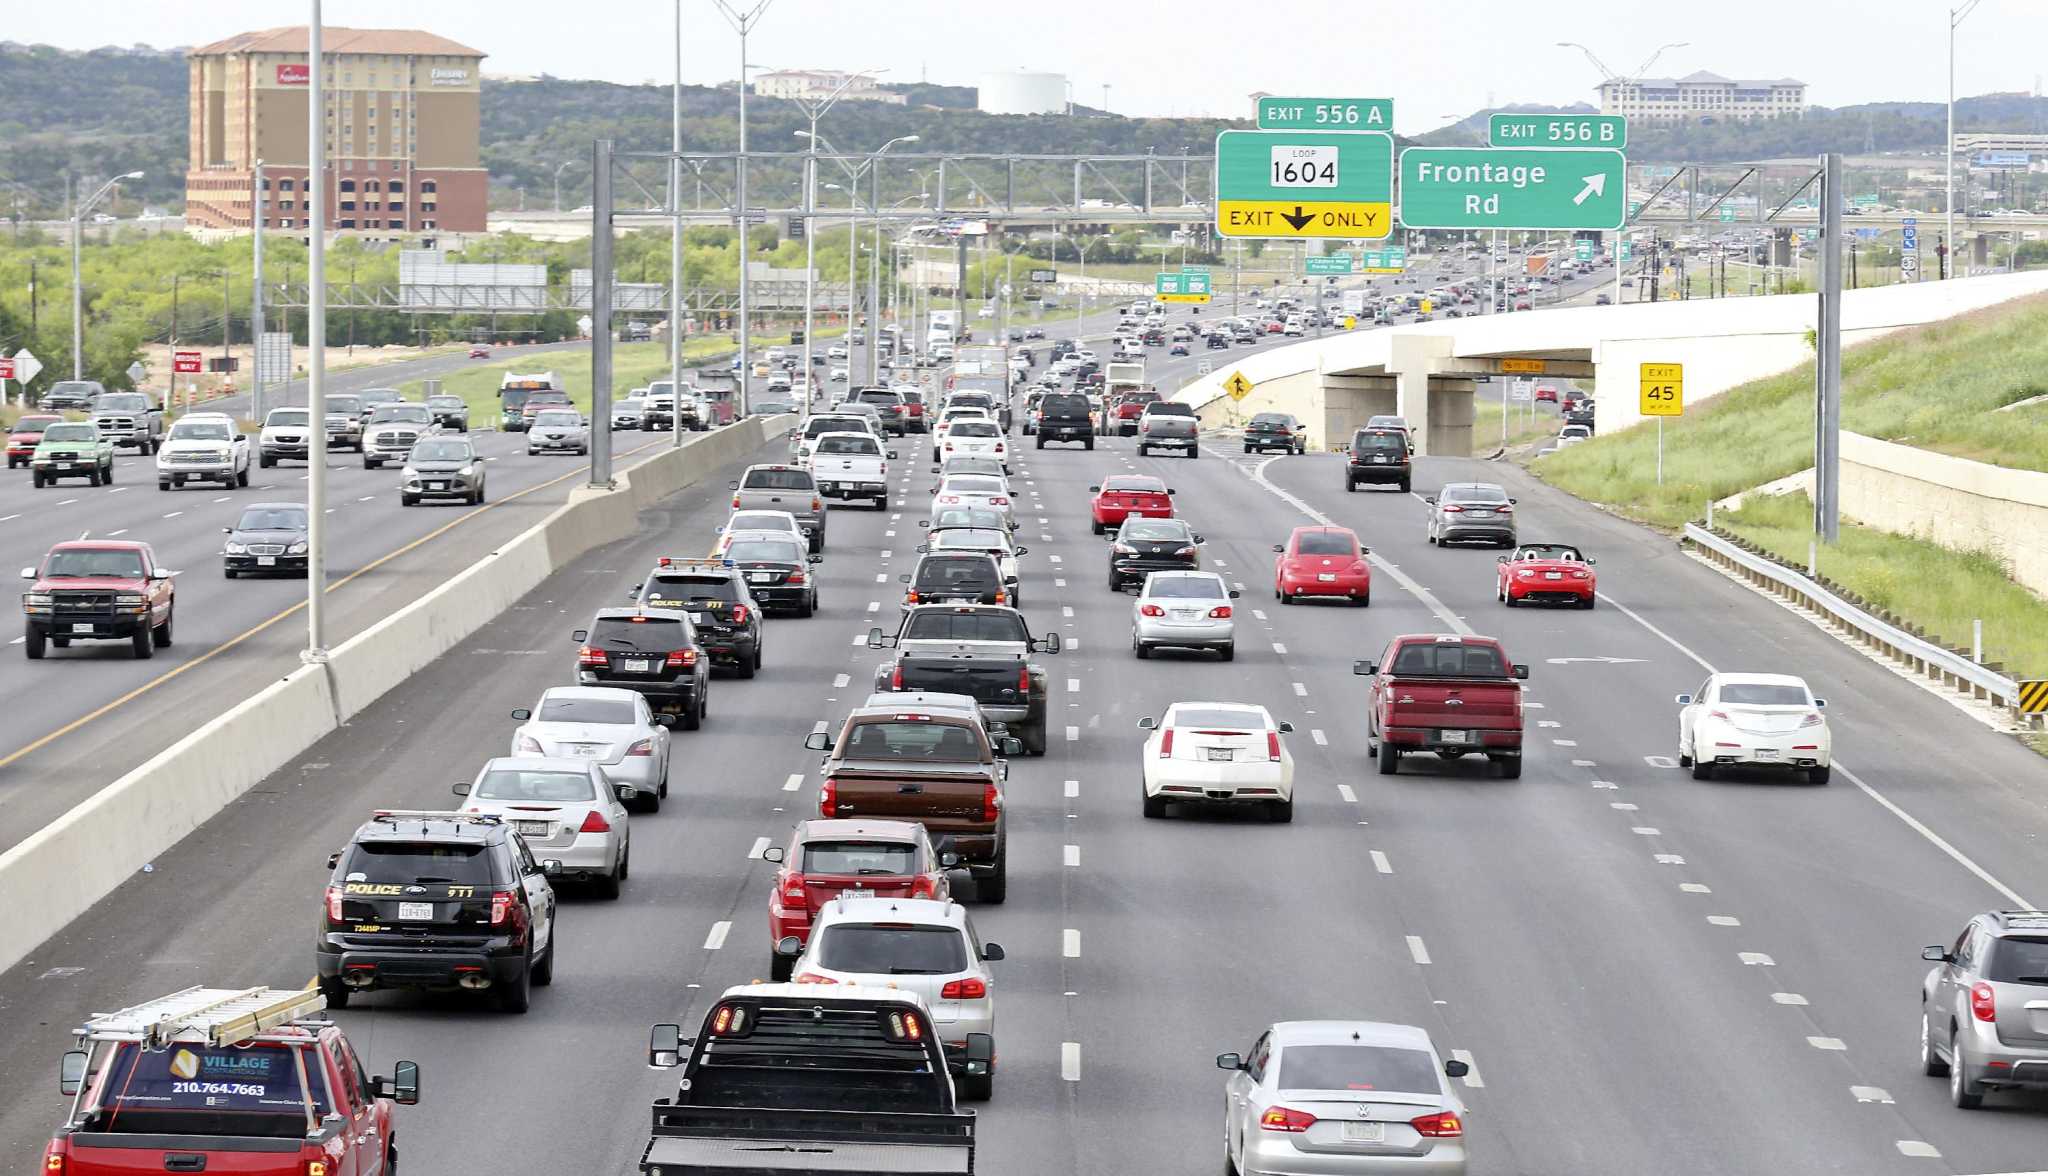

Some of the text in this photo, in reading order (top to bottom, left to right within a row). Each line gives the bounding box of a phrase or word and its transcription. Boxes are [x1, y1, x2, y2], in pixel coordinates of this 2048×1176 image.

[1268, 105, 1384, 125] EXIT 556 A
[1501, 121, 1615, 142] EXIT 556 B
[1292, 149, 1318, 158] LOOP
[1273, 160, 1336, 184] 1604
[1418, 162, 1547, 188] Frontage
[1465, 194, 1500, 215] Rd
[1230, 211, 1377, 227] EXIT ONLY
[1649, 368, 1674, 377] EXIT
[1647, 386, 1674, 401] 45
[345, 883, 402, 895] POLICE
[448, 889, 473, 898] 911
[204, 1056, 270, 1069] VILLAGE
[172, 1082, 265, 1097] 210.764.7663
